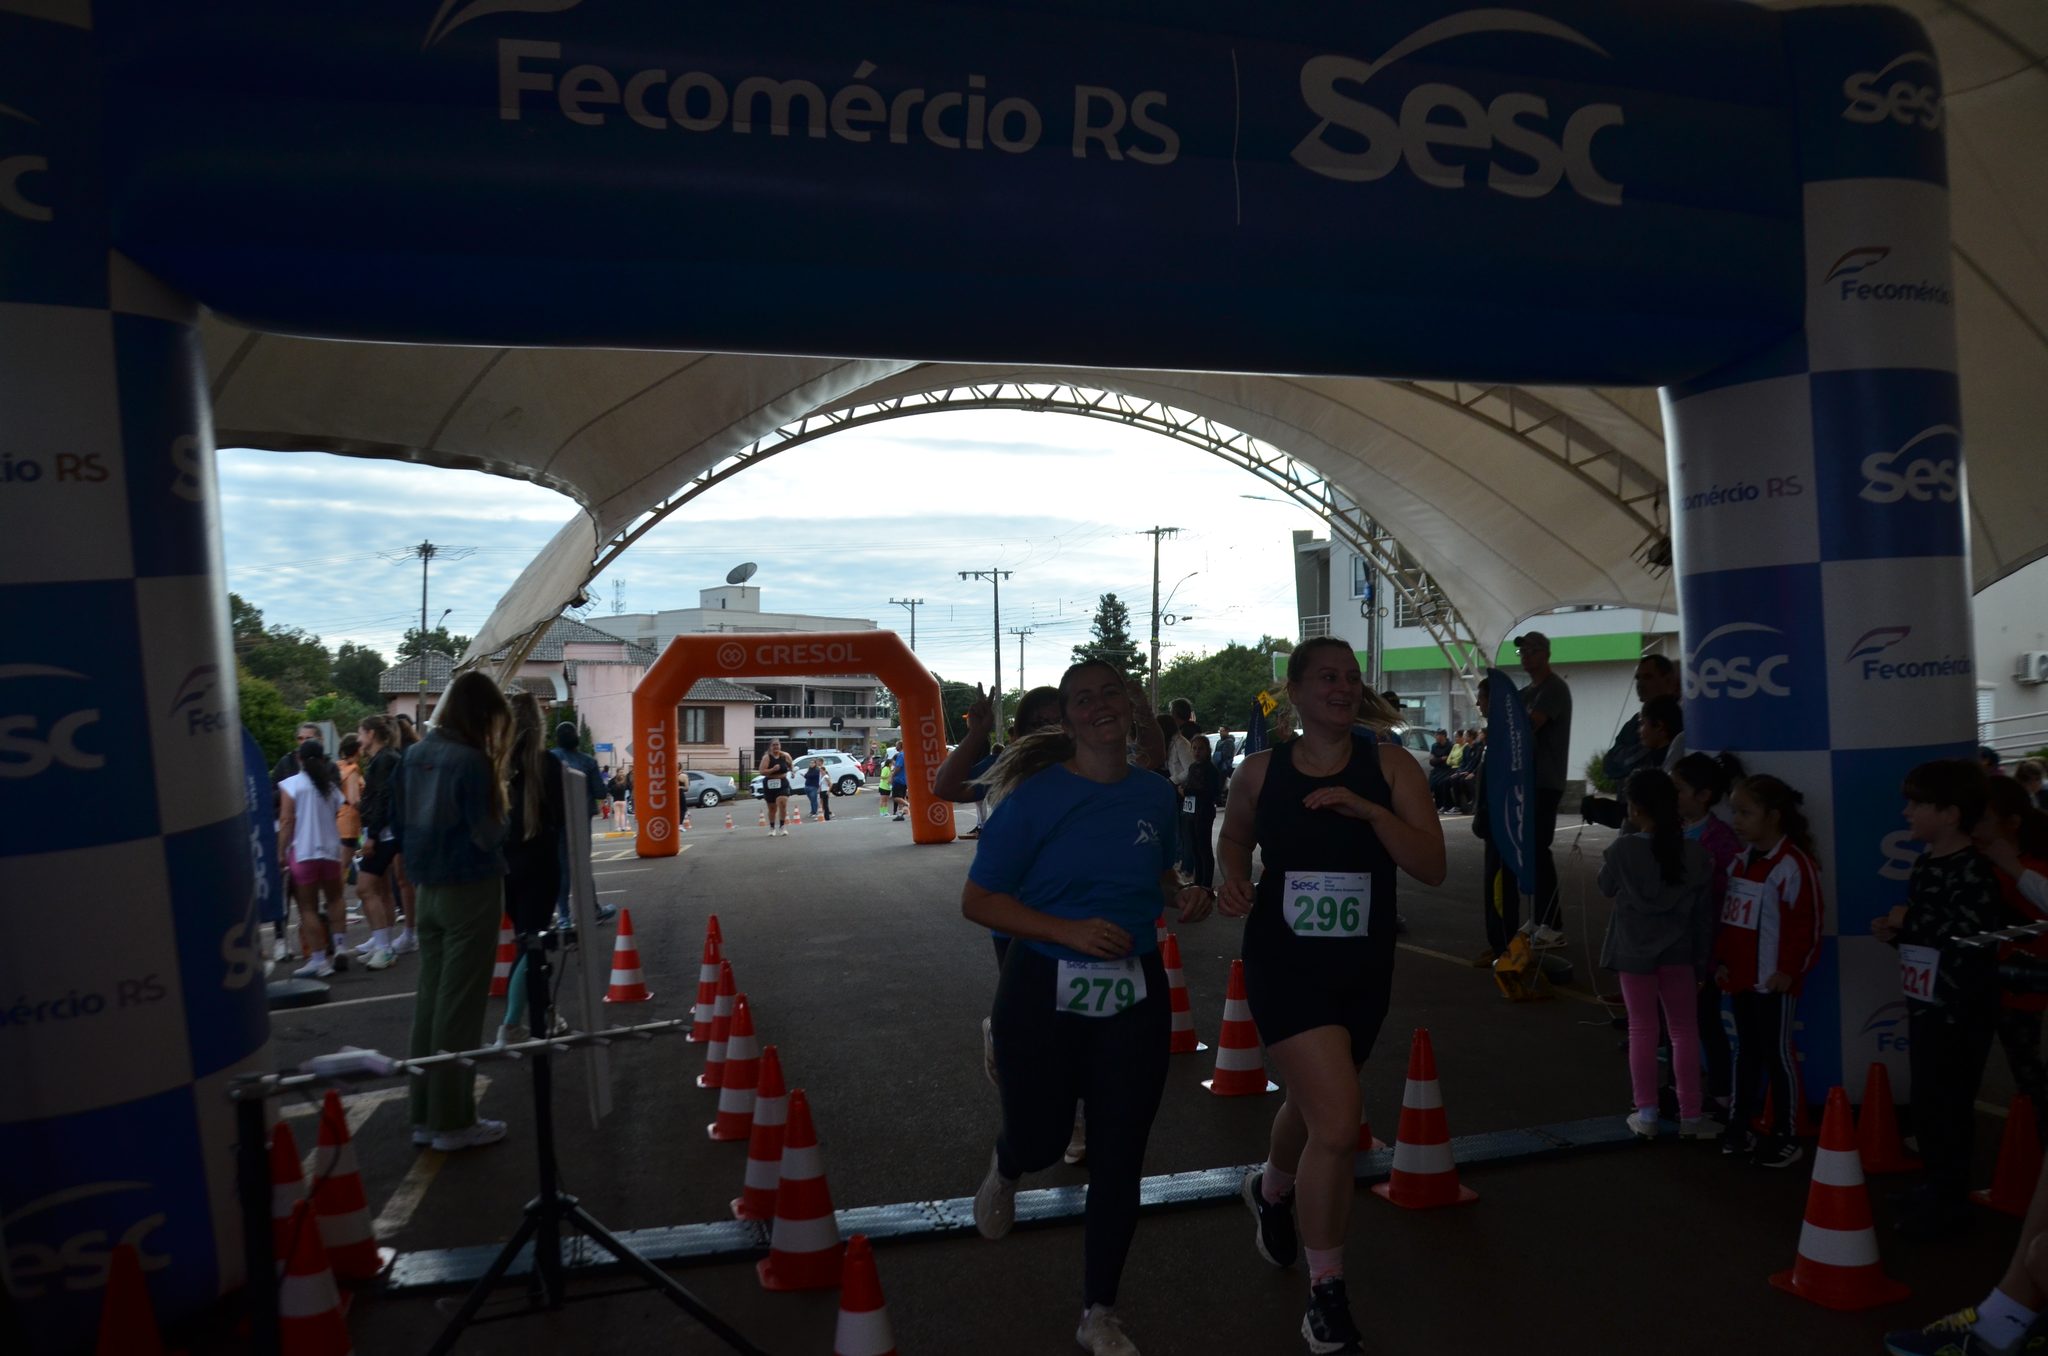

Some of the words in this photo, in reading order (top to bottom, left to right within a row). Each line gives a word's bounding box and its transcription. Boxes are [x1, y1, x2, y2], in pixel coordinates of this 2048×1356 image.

[498, 37, 1043, 154] Fecomércio
[1072, 84, 1181, 165] RS
[56, 452, 109, 482] RS
[1766, 475, 1804, 498] RS
[756, 642, 862, 665] CRESOL
[648, 720, 667, 810] CRESOL
[1293, 895, 1360, 932] 296
[117, 973, 167, 1007] RS
[1068, 977, 1136, 1014] 279
